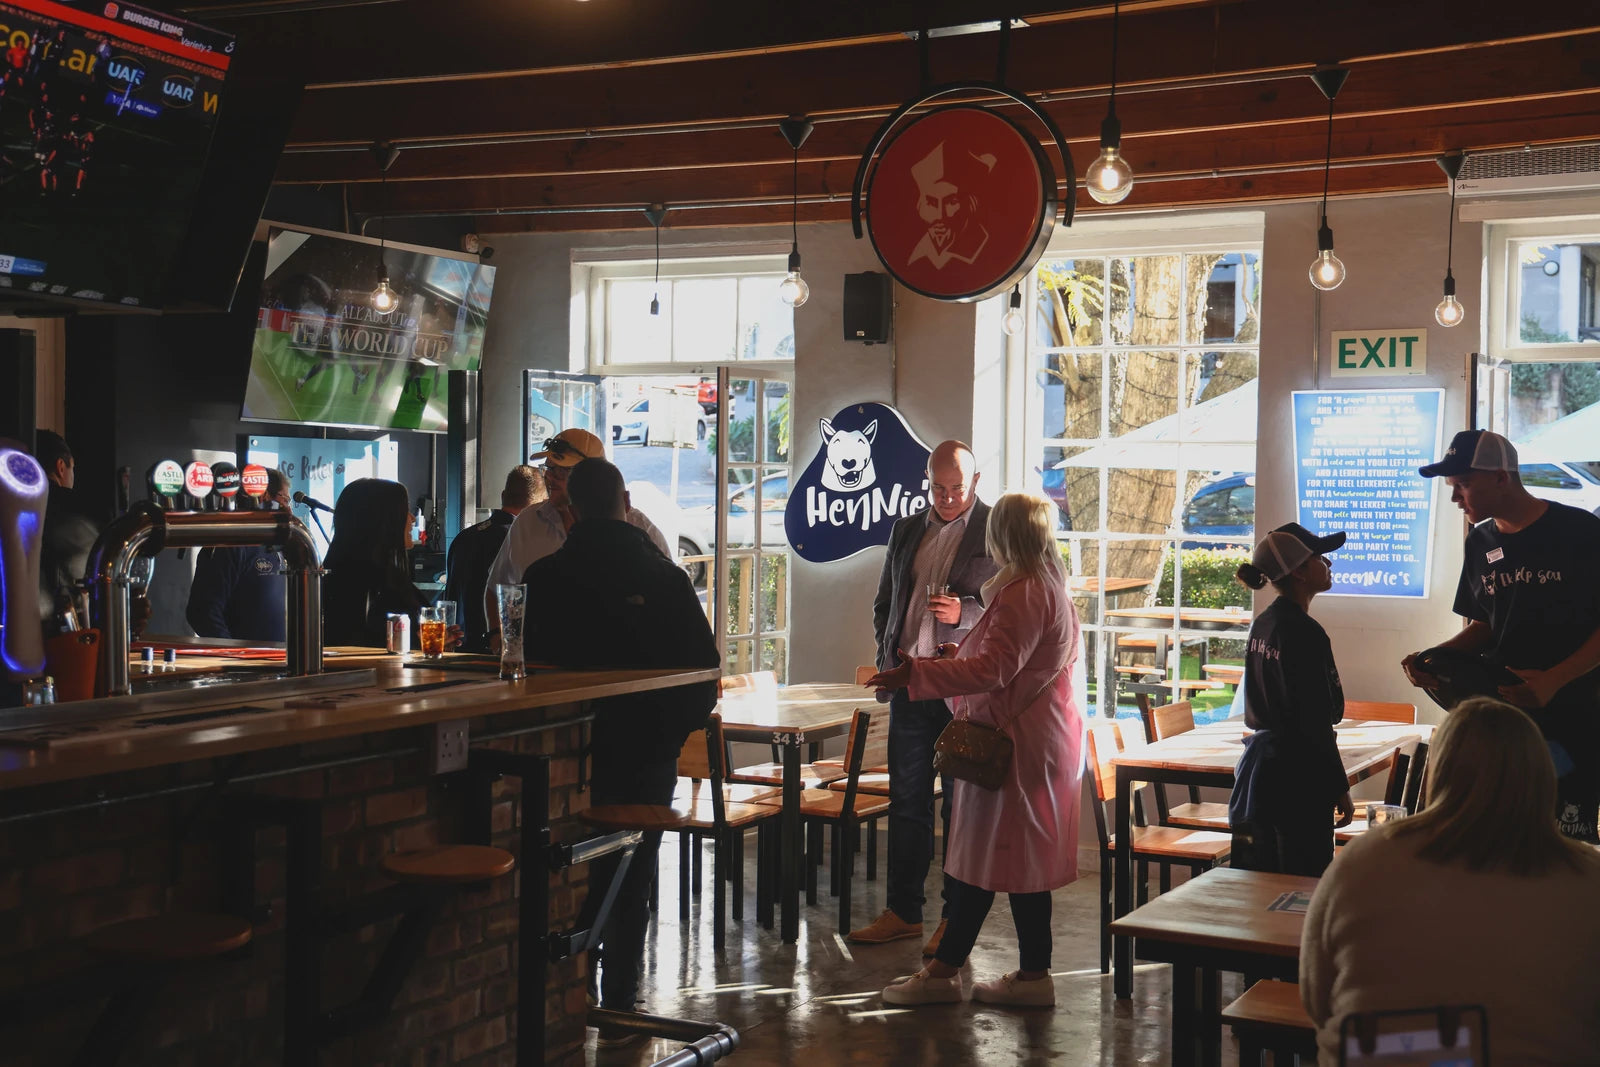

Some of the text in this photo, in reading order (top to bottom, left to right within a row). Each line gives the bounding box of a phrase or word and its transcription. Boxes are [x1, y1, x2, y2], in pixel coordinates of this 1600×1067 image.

[123, 10, 184, 36] BURGER KING
[181, 37, 206, 52] Variety
[163, 80, 194, 102] UAR
[336, 326, 408, 356] WORLD
[411, 337, 449, 360] CUP
[1338, 336, 1419, 369] EXIT
[1323, 448, 1332, 456] TO
[1334, 448, 1366, 457] QUICKLY
[1367, 448, 1387, 456] JUST
[1302, 459, 1322, 467] WITH
[1323, 459, 1329, 467] A
[1357, 459, 1366, 467] IN
[1367, 459, 1388, 467] YOUR
[1390, 459, 1406, 467] LEFT
[1408, 458, 1429, 467] HAND
[1315, 469, 1331, 477] AND
[1332, 469, 1339, 477] A
[1340, 469, 1366, 477] LEKKER
[1367, 469, 1399, 477] STUKKIE
[1306, 479, 1321, 488] FOR
[1323, 479, 1337, 488] THE
[1338, 479, 1355, 488] HEEL
[1356, 479, 1396, 488] LEKKERSTE
[1305, 490, 1326, 498] WITH
[1327, 490, 1333, 498] A
[1376, 490, 1393, 499] AND
[1394, 490, 1400, 499] A
[806, 479, 934, 531] HenNie'
[1301, 500, 1312, 508] OR
[1313, 500, 1323, 508] TO
[1325, 500, 1349, 508] SHARE
[1350, 500, 1359, 509] 'N
[1360, 501, 1387, 509] LEKKER
[1408, 500, 1429, 509] WITH
[1312, 511, 1333, 519] YOUR
[1350, 511, 1373, 520] WHEN
[1375, 512, 1394, 520] THEY
[1395, 511, 1417, 520] DORS
[1319, 521, 1327, 529] IF
[1328, 521, 1344, 529] YOU
[1345, 522, 1359, 530] ARE
[1361, 522, 1375, 530] LUS
[1376, 522, 1391, 530] FOR
[1394, 533, 1410, 541] KOU
[1343, 543, 1364, 551] YOUR
[1365, 543, 1390, 551] PARTY
[1367, 553, 1391, 562] PLACE
[1392, 553, 1402, 562] TO
[772, 731, 790, 745] 34
[795, 732, 805, 745] 34
